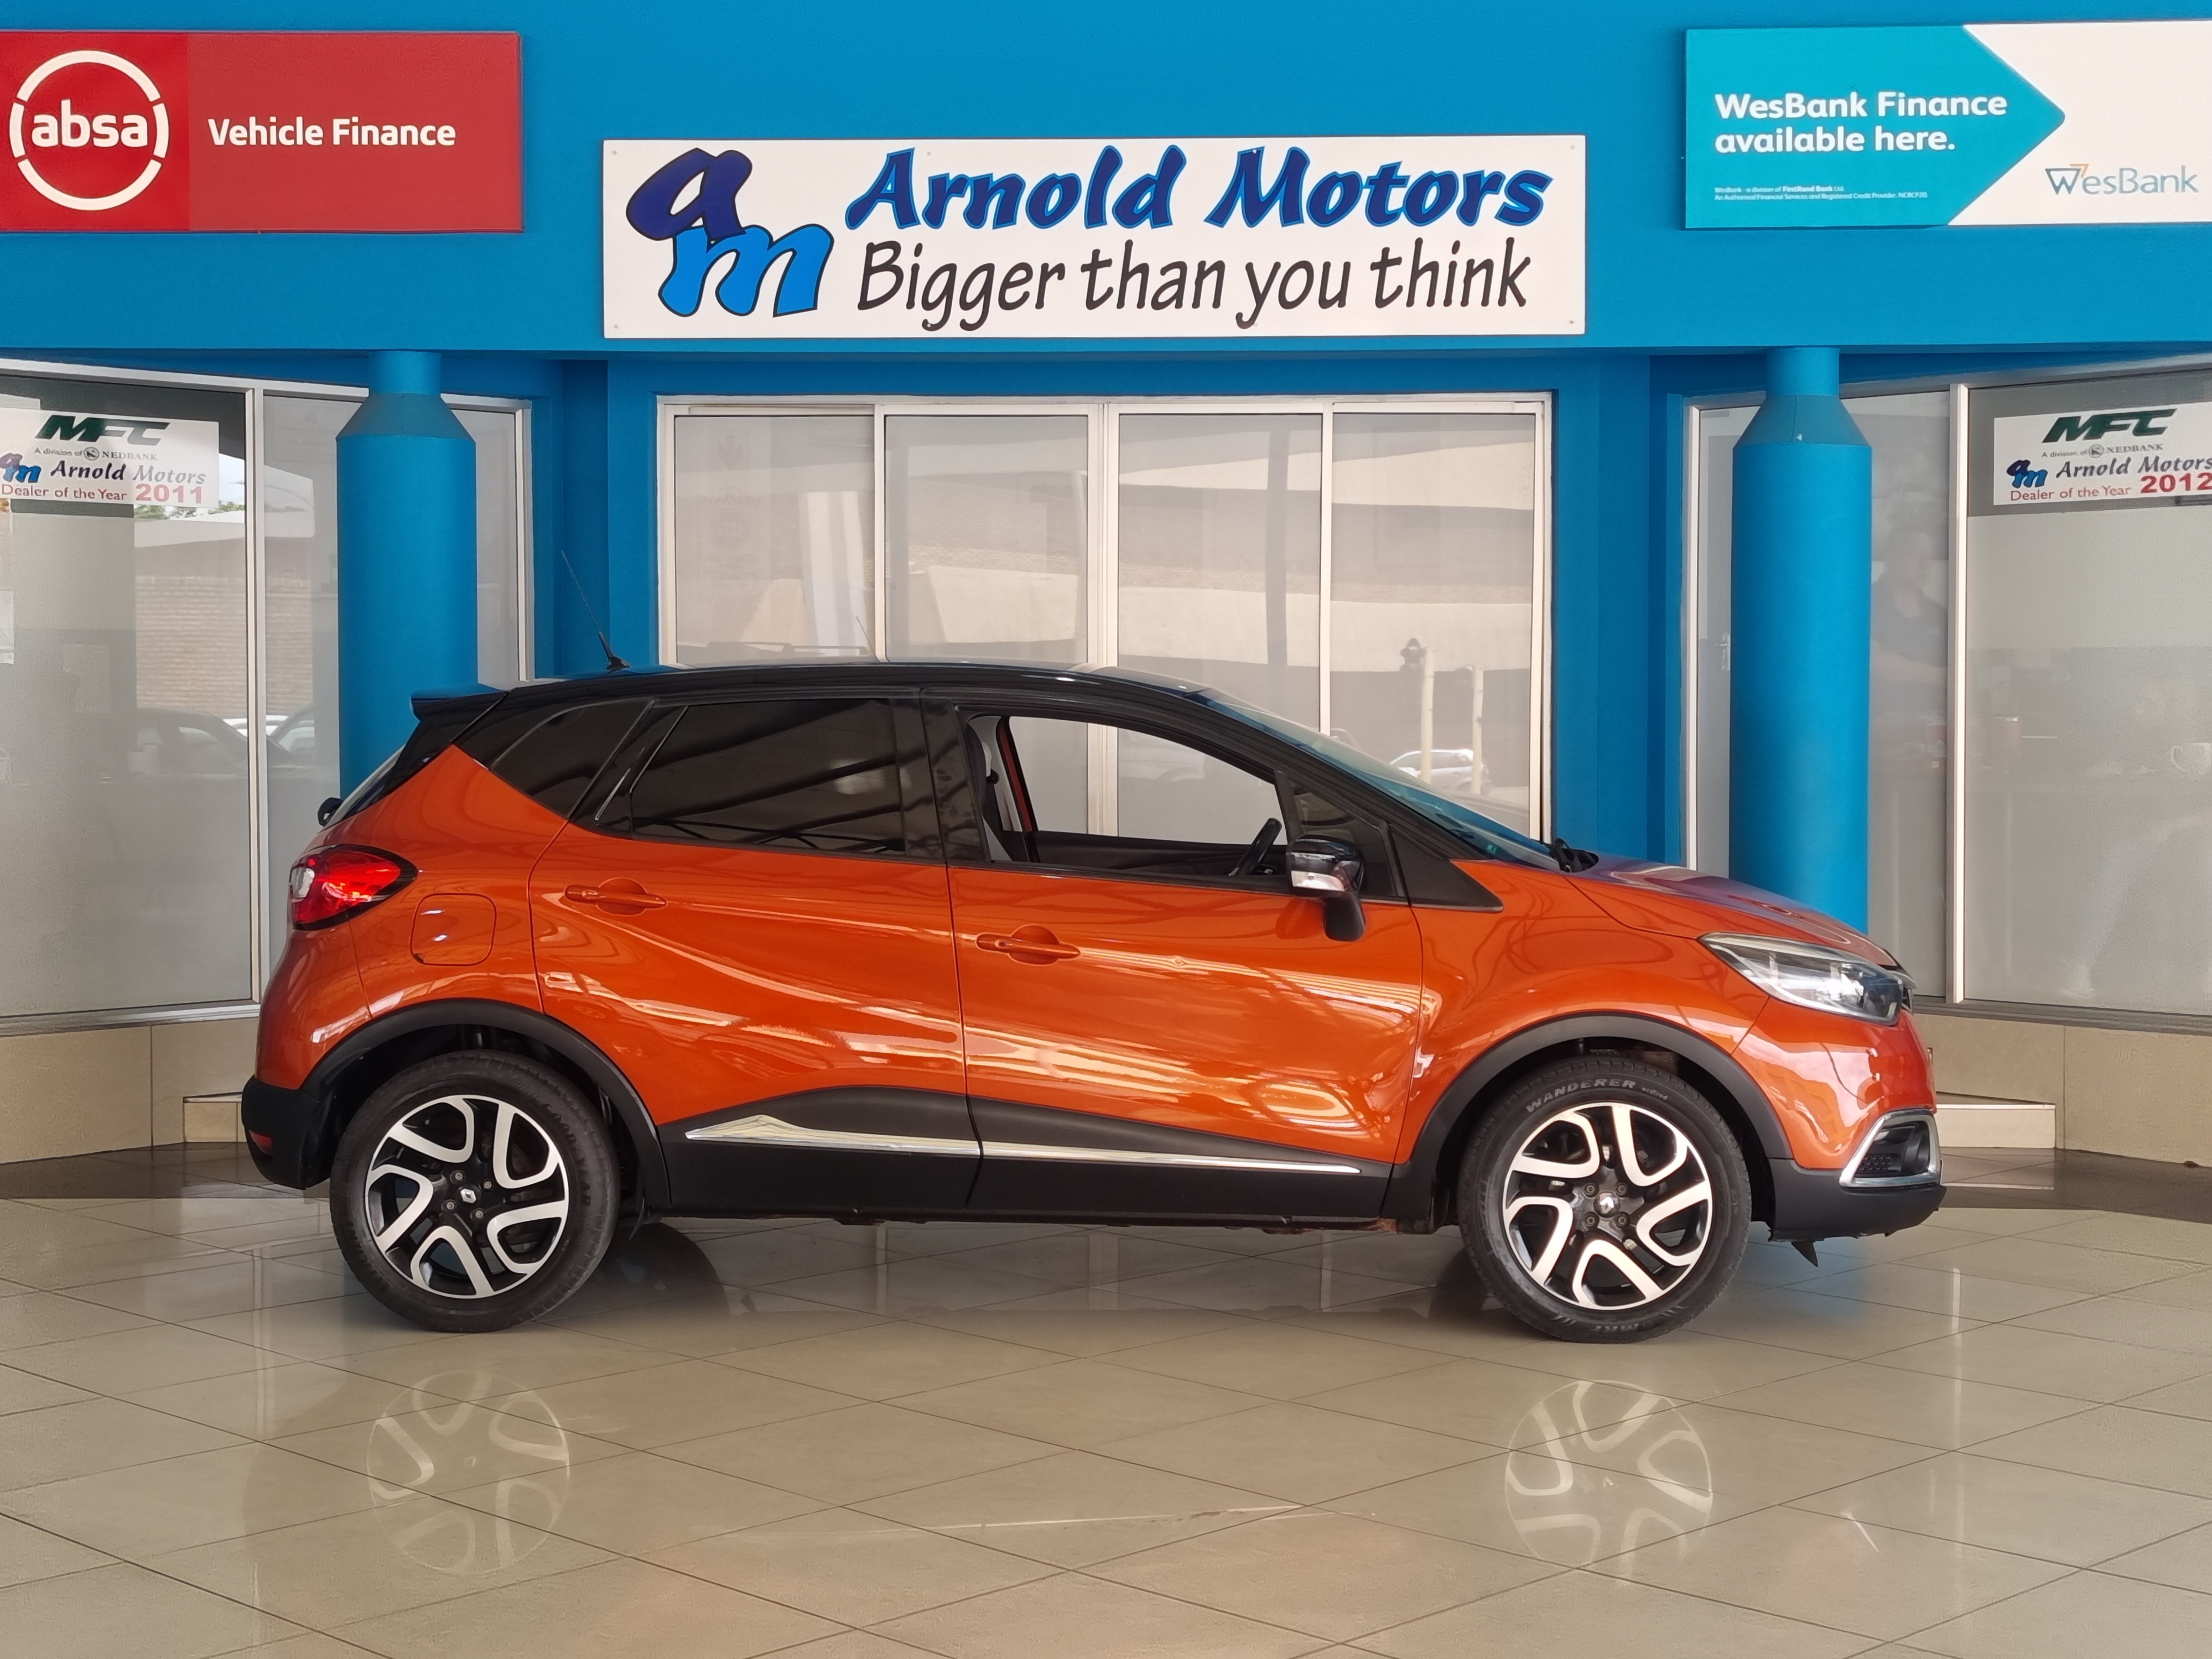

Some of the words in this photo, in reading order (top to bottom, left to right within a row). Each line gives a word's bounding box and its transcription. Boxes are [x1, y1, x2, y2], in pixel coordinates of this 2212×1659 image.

[1715, 92, 1867, 119] WesBank
[1877, 91, 2007, 117] Finance
[32, 99, 148, 148] absa
[208, 116, 324, 146] Vehicle
[333, 116, 456, 146] Finance
[1715, 127, 1865, 154] available
[1875, 126, 1955, 152] here.
[845, 144, 1187, 230] Arnold
[1203, 145, 1554, 228] Motors
[2044, 164, 2200, 196] WesBank
[857, 240, 1066, 332] Bigger
[1081, 239, 1226, 311] than
[1235, 260, 1351, 330] you
[1370, 237, 1531, 309] think
[34, 414, 170, 446] MFC
[2042, 408, 2177, 443] MFC
[102, 451, 158, 461] NEDBANK
[2106, 443, 2163, 454] NEDBANK
[50, 460, 127, 480] Arnold
[133, 465, 206, 485] Motors
[2056, 456, 2132, 479] Arnold
[2137, 455, 2212, 474] Motors
[2, 483, 49, 497] Dealer
[55, 487, 69, 498] of
[74, 487, 95, 499] the
[97, 488, 127, 501] Year
[136, 483, 202, 504] 2011
[2011, 489, 2055, 501] Dealer
[2060, 487, 2073, 498] of
[2078, 486, 2099, 497] the
[2101, 485, 2133, 496] Year
[2140, 472, 2212, 493] 2012
[1525, 1078, 1636, 1113] WANDERER
